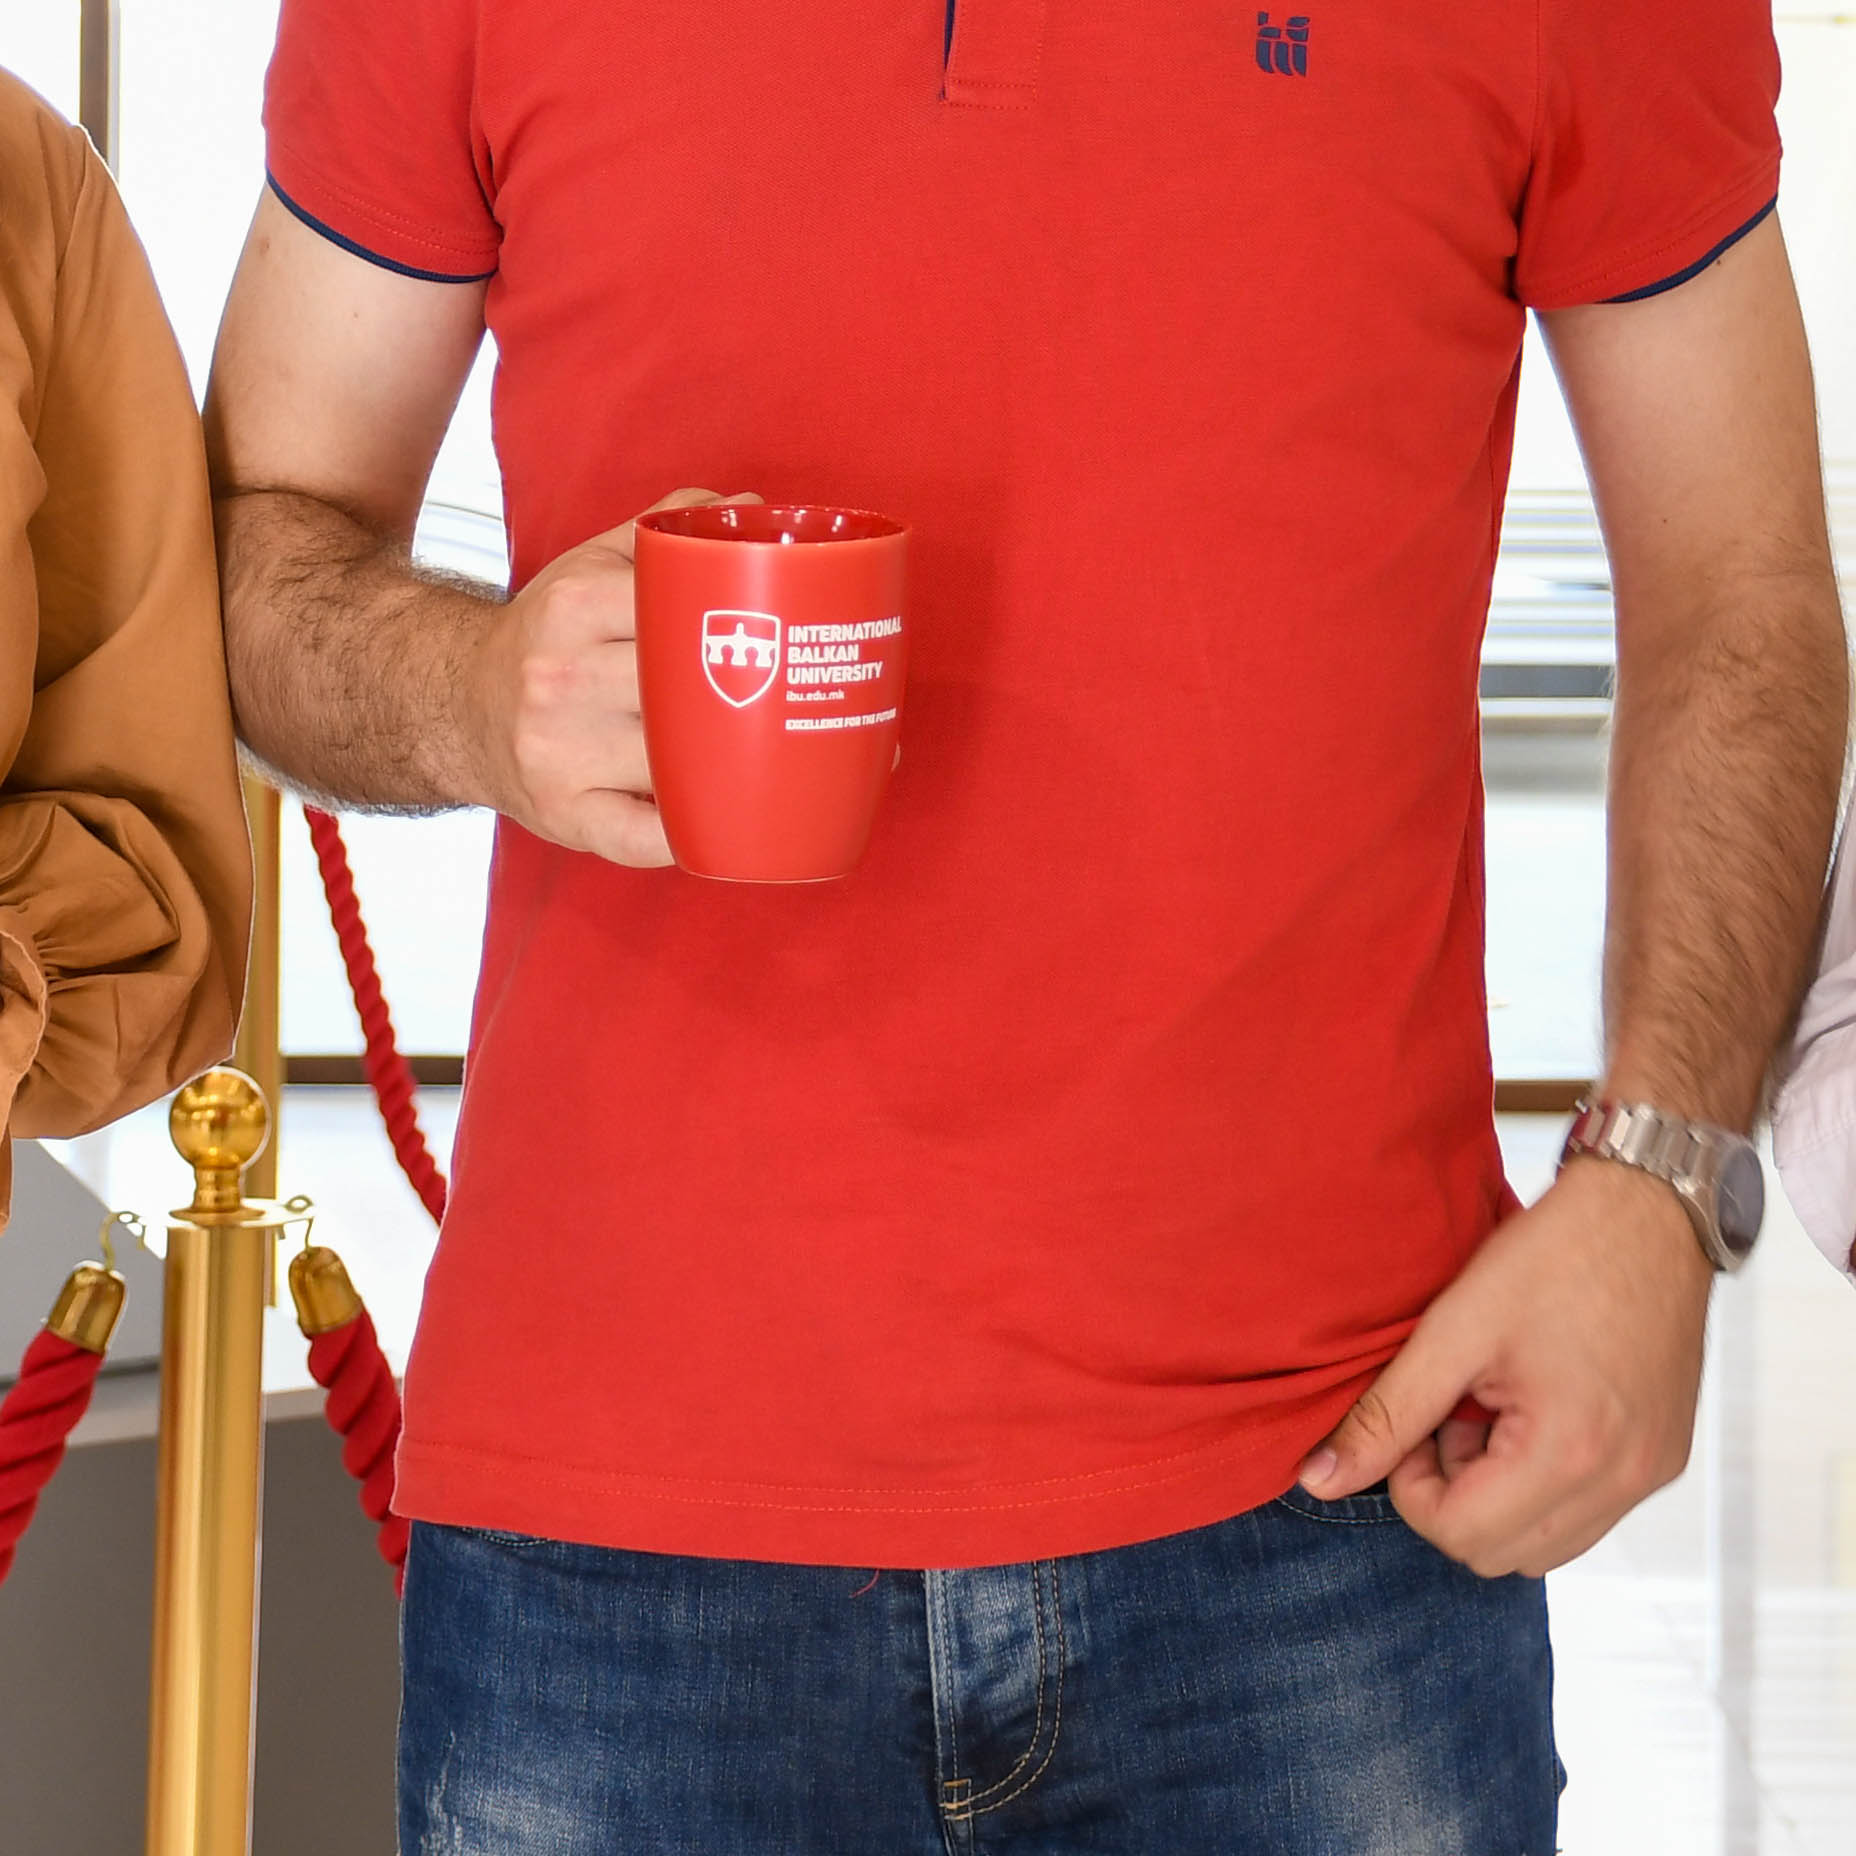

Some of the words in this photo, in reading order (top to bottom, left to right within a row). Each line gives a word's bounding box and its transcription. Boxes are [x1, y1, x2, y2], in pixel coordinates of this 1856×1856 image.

[788, 616, 902, 643] INTERNATIONAL
[787, 644, 859, 664] BALKAN
[786, 661, 883, 684] UNIVERSITY
[786, 689, 845, 702] ibu.edu.mk
[785, 718, 843, 730] EXCELLENCE
[844, 716, 861, 728] FOR
